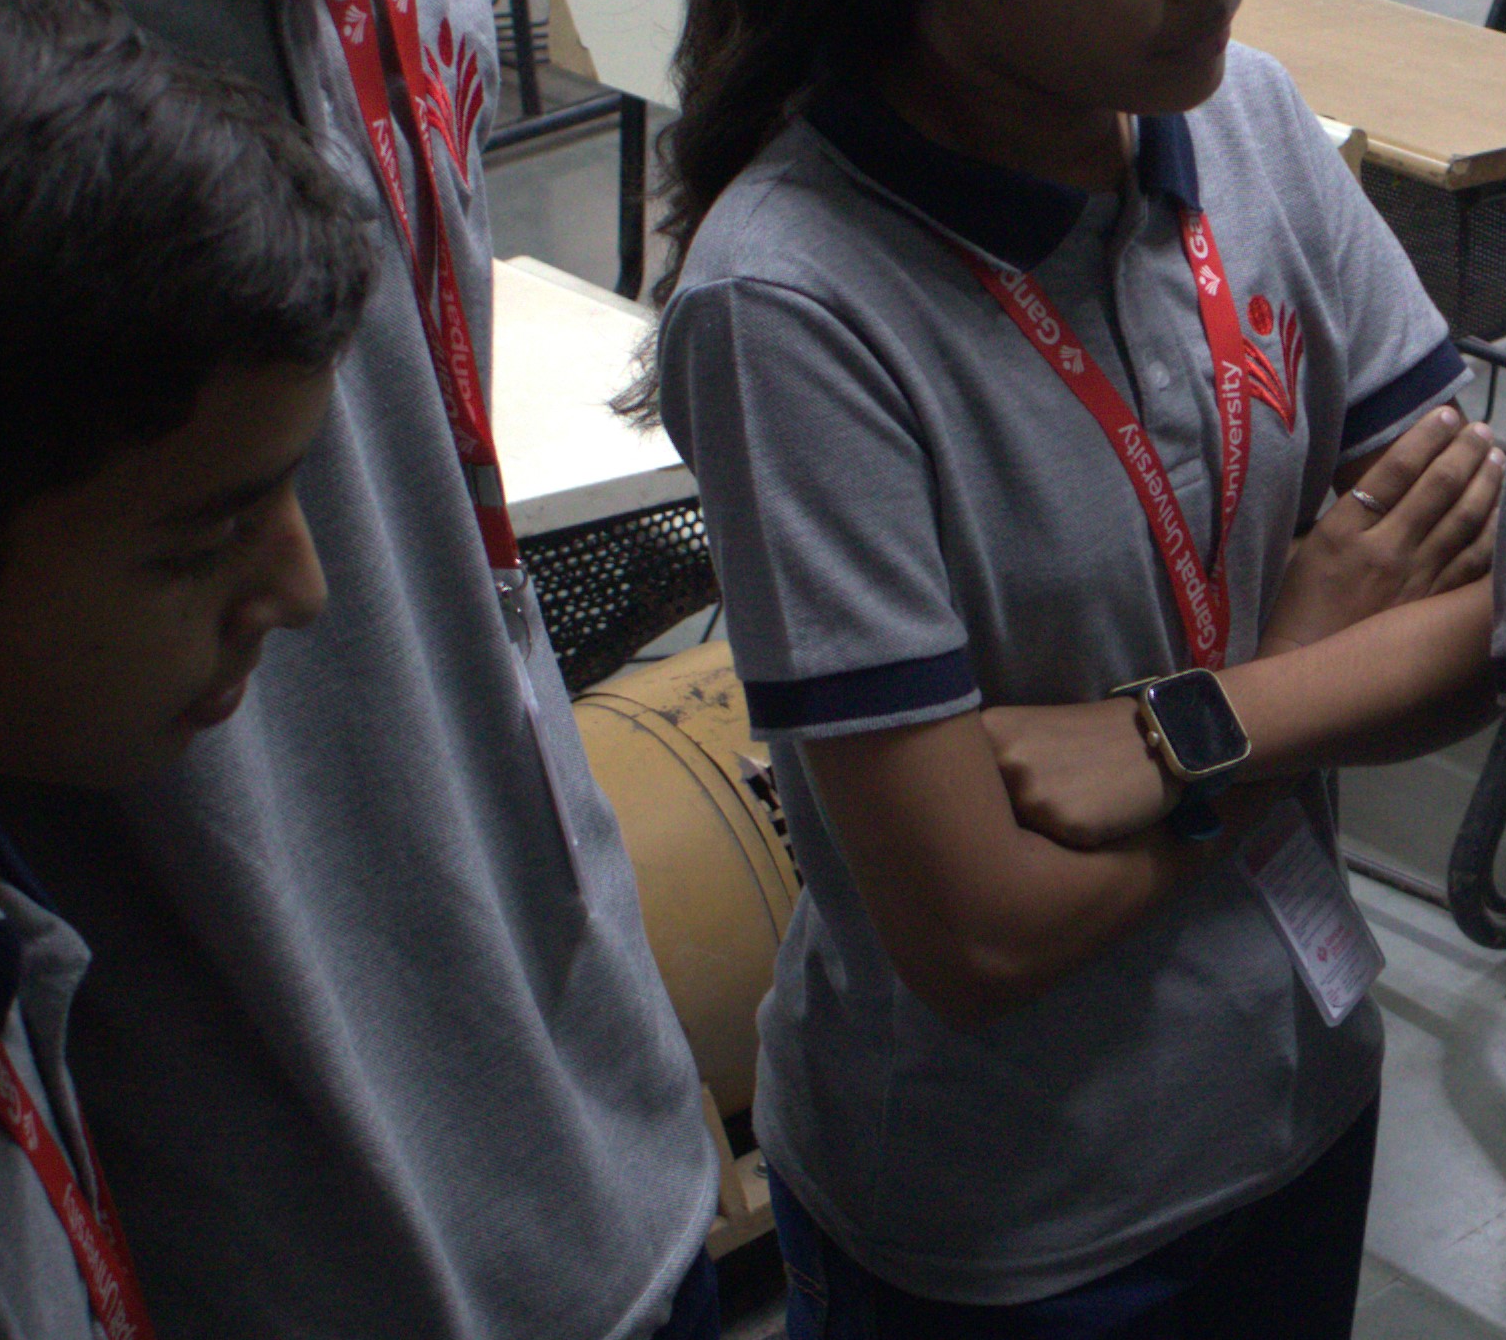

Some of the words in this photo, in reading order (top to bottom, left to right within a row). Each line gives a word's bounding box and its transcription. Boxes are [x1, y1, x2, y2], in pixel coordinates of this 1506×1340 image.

[1116, 422, 1184, 558] University
[1221, 359, 1243, 515] University
[1174, 550, 1218, 653] Ganpat
